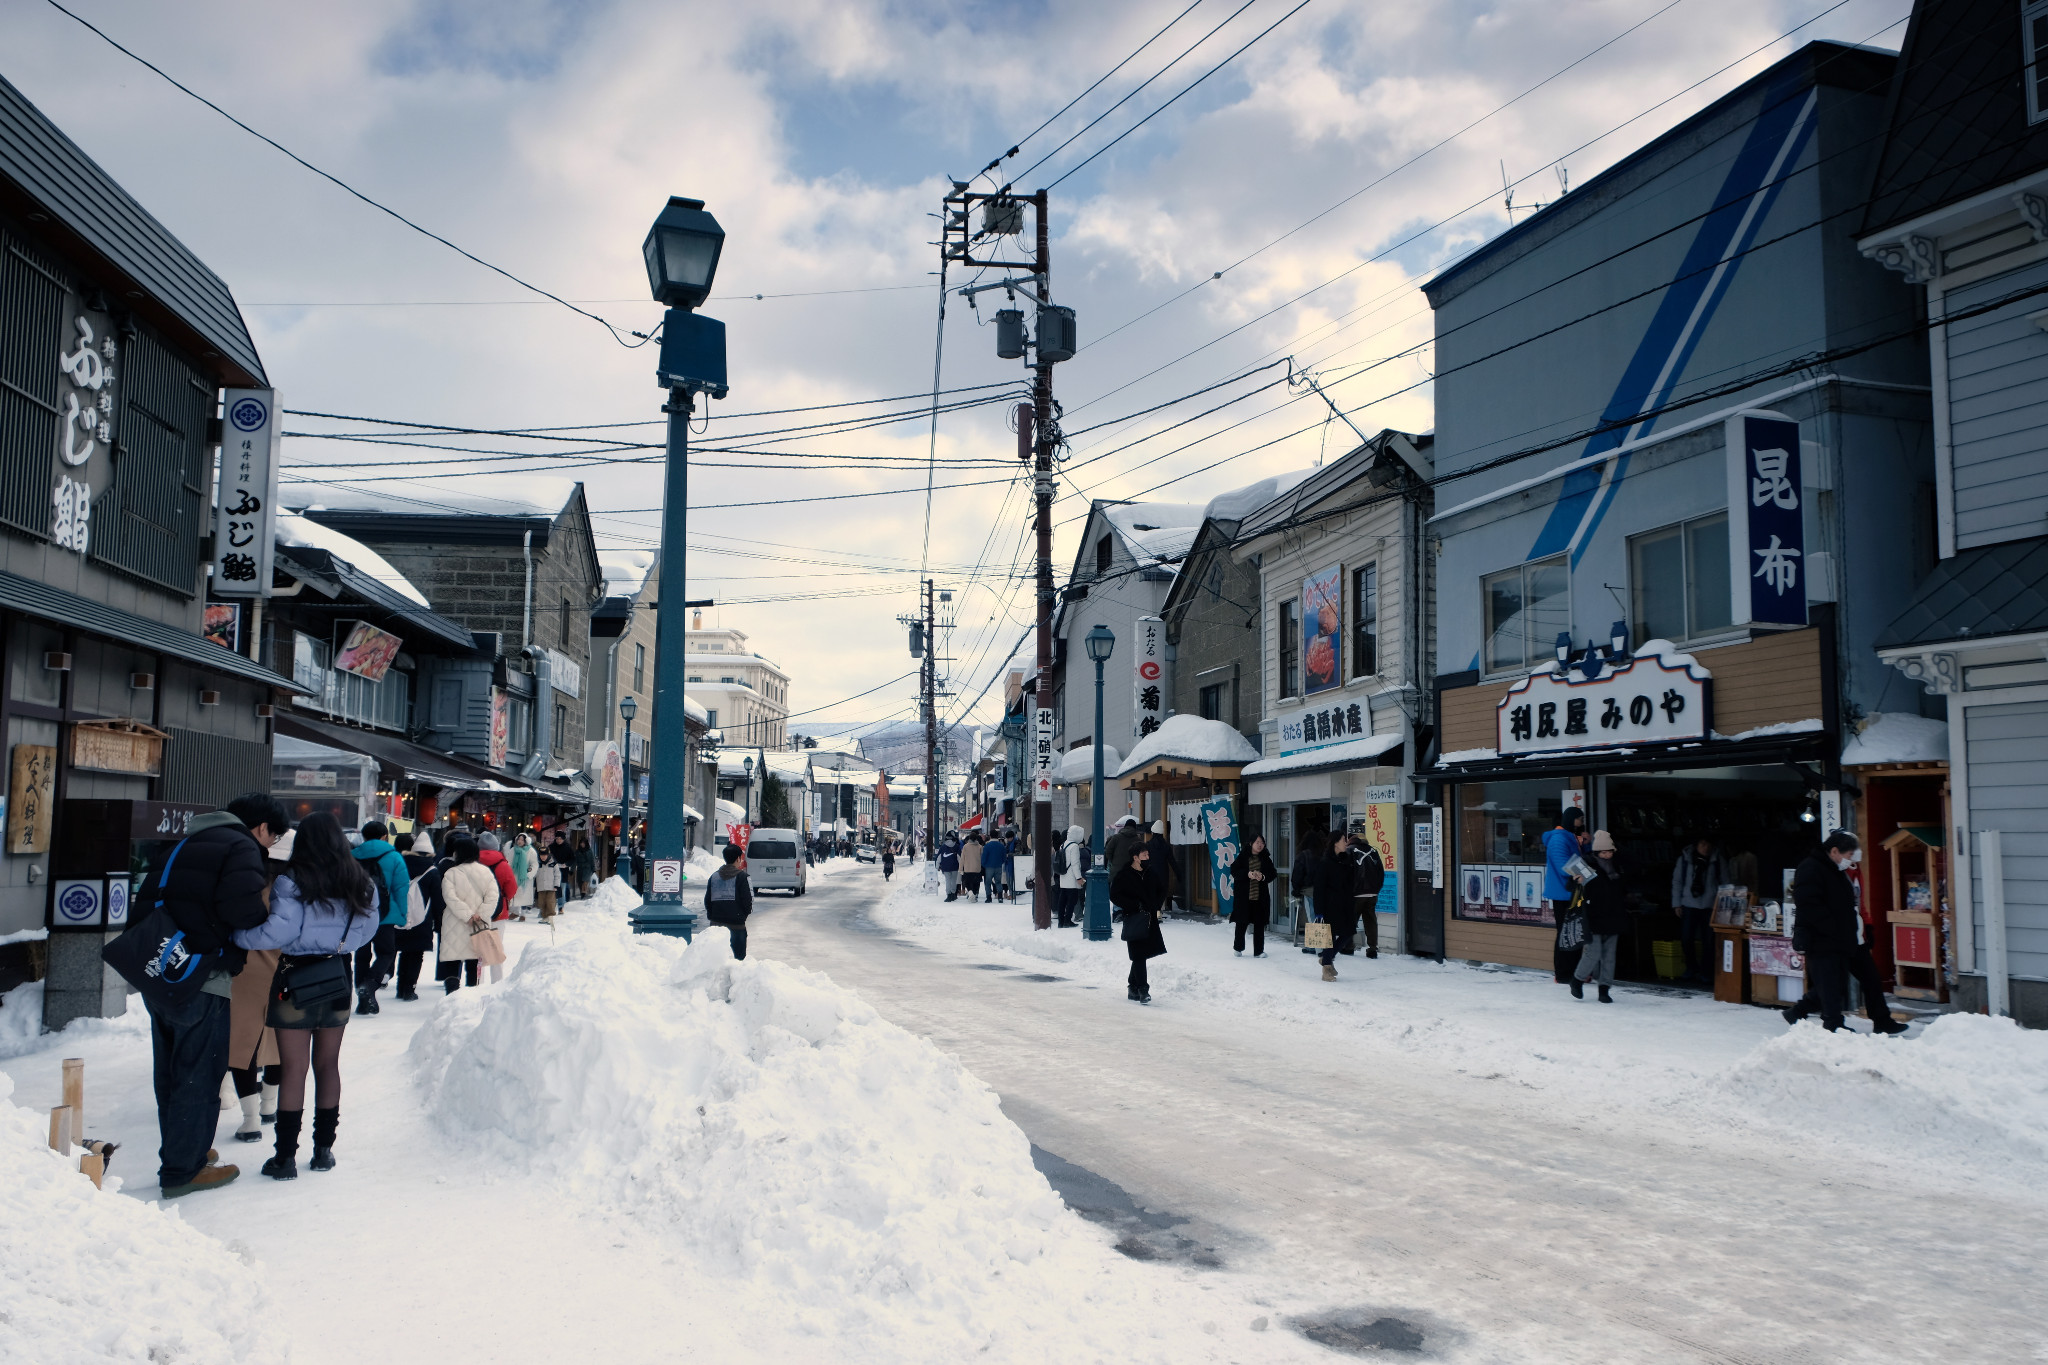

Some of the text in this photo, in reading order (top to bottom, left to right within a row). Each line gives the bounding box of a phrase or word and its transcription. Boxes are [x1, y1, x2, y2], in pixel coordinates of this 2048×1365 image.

[97, 335, 117, 443] 積丹料理
[53, 315, 102, 554] ふじ鮨
[238, 440, 252, 483] 積丹料理
[220, 489, 261, 582] ふじ鮨
[1751, 447, 1802, 596] 昆布
[1304, 574, 1338, 614] ゆでたて
[1145, 626, 1156, 657] おたる
[1037, 711, 1051, 770] 北一硝子
[1283, 703, 1362, 744] おたる 高橋水産
[1510, 689, 1686, 741] 利尻屋 みのや
[1366, 789, 1396, 800] いらっしゃいませ
[1368, 805, 1394, 869] 活かにの店
